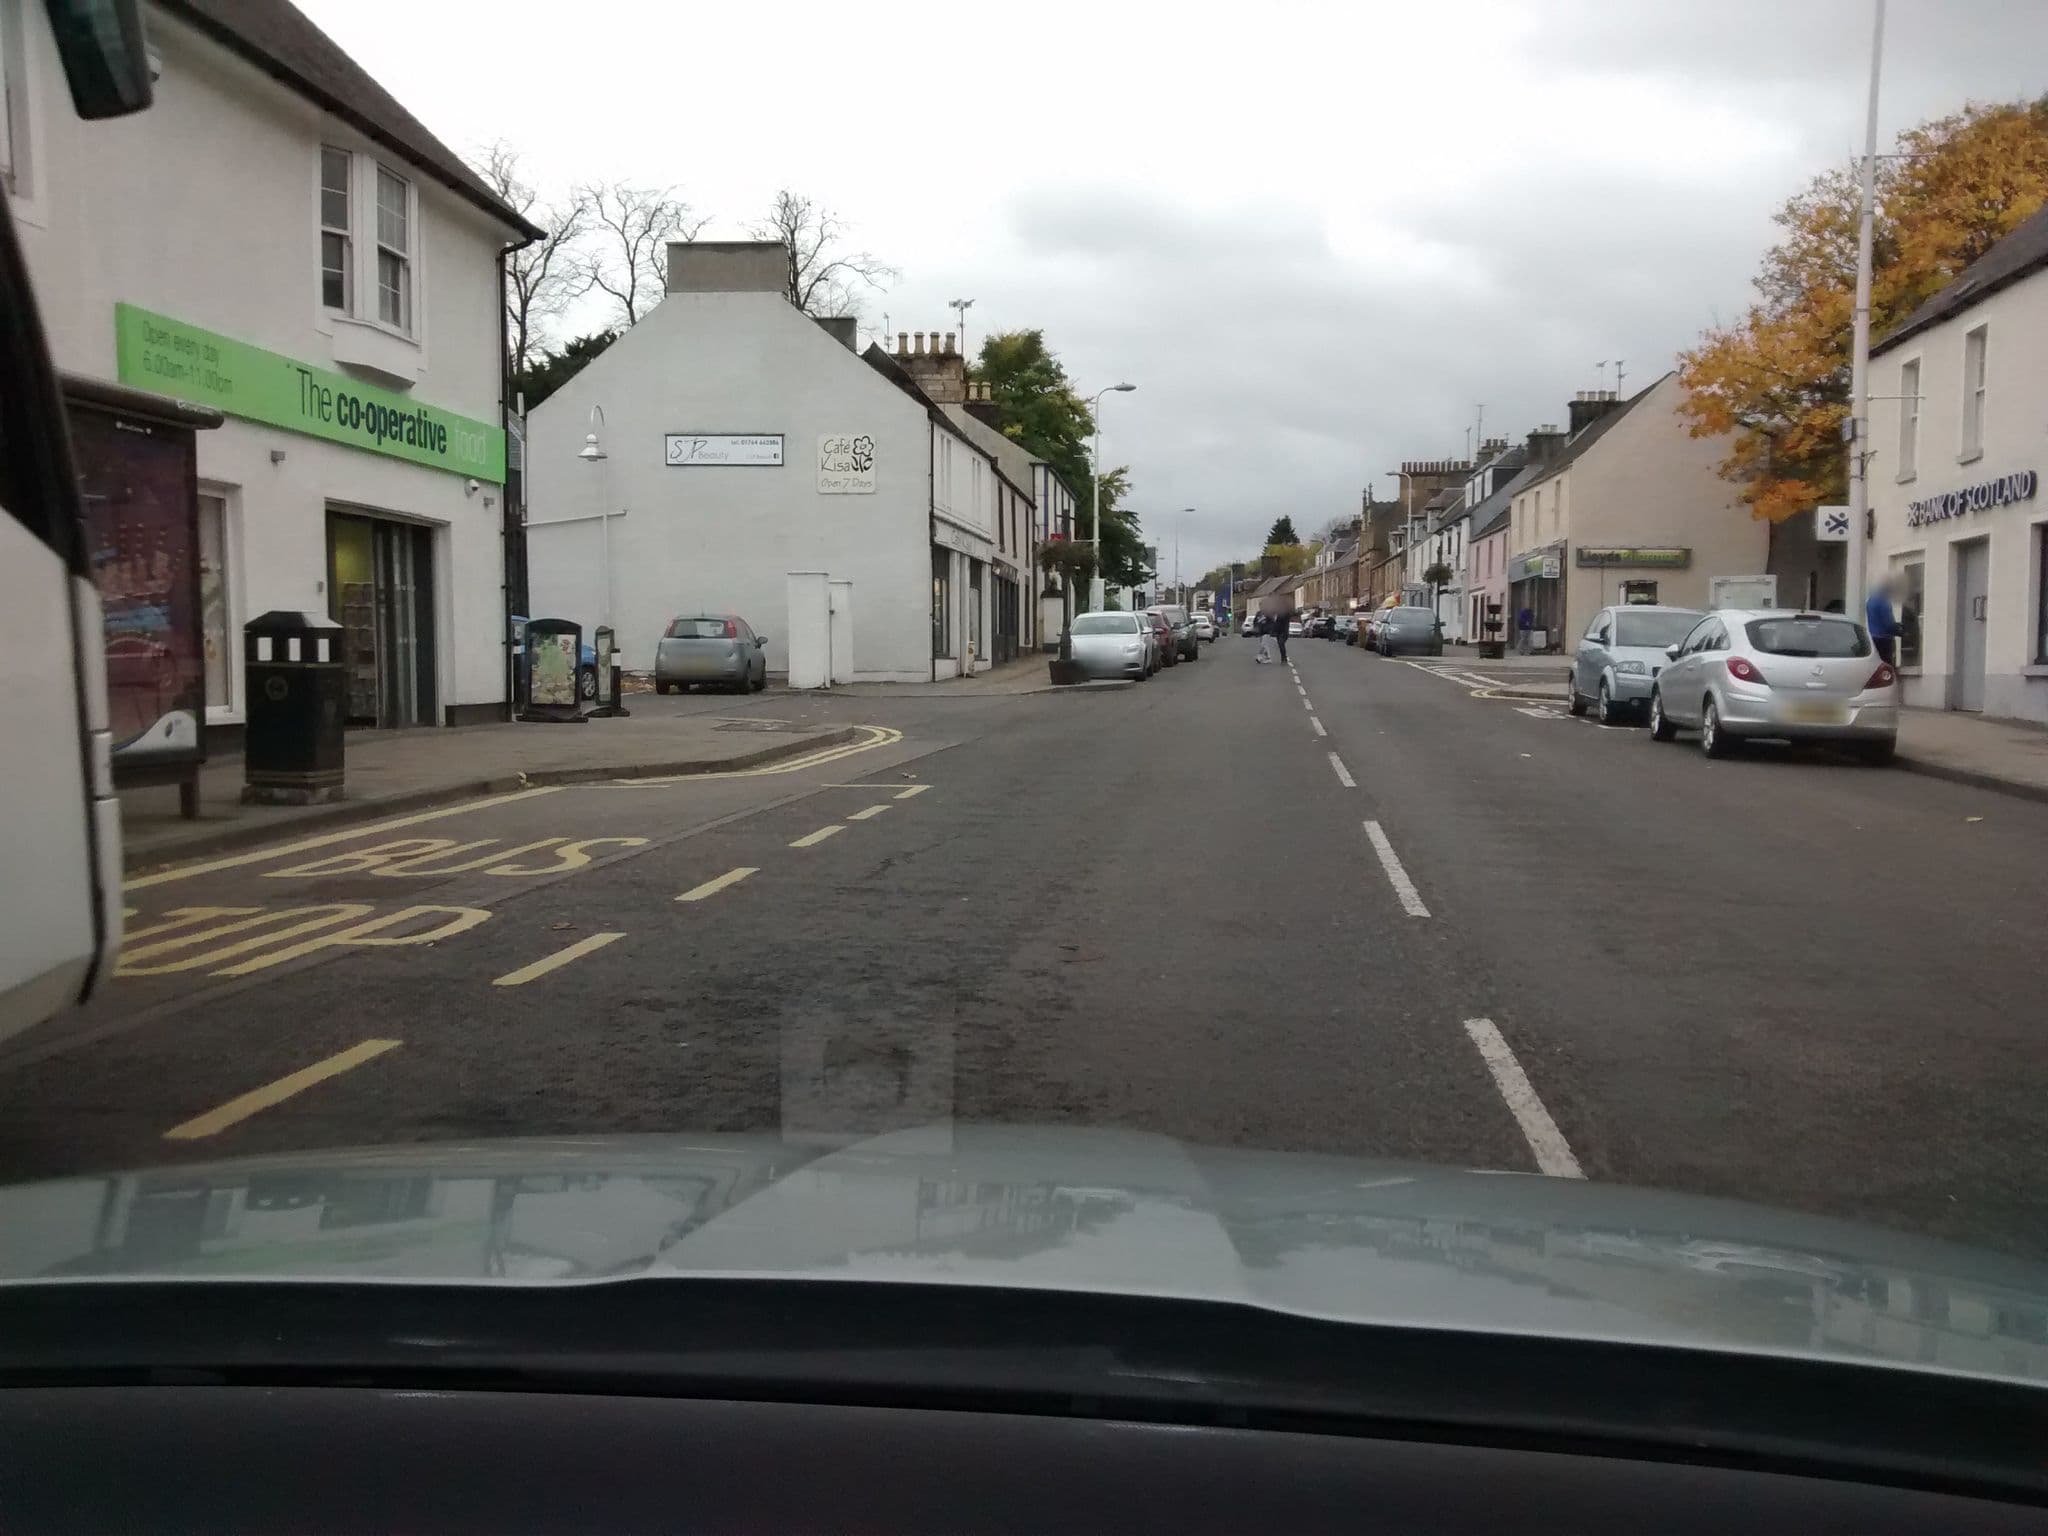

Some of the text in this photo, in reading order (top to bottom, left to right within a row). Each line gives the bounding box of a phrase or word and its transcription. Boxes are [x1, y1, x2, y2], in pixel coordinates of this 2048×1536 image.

[297, 367, 488, 465] The co-operative food
[698, 450, 729, 461] Beauty
[820, 454, 851, 473] Kisa
[821, 477, 873, 489] Open 7 Days
[1918, 469, 2037, 525] BANK OF SCOTLAND
[259, 838, 651, 878] BUS
[113, 903, 493, 977] TOP
